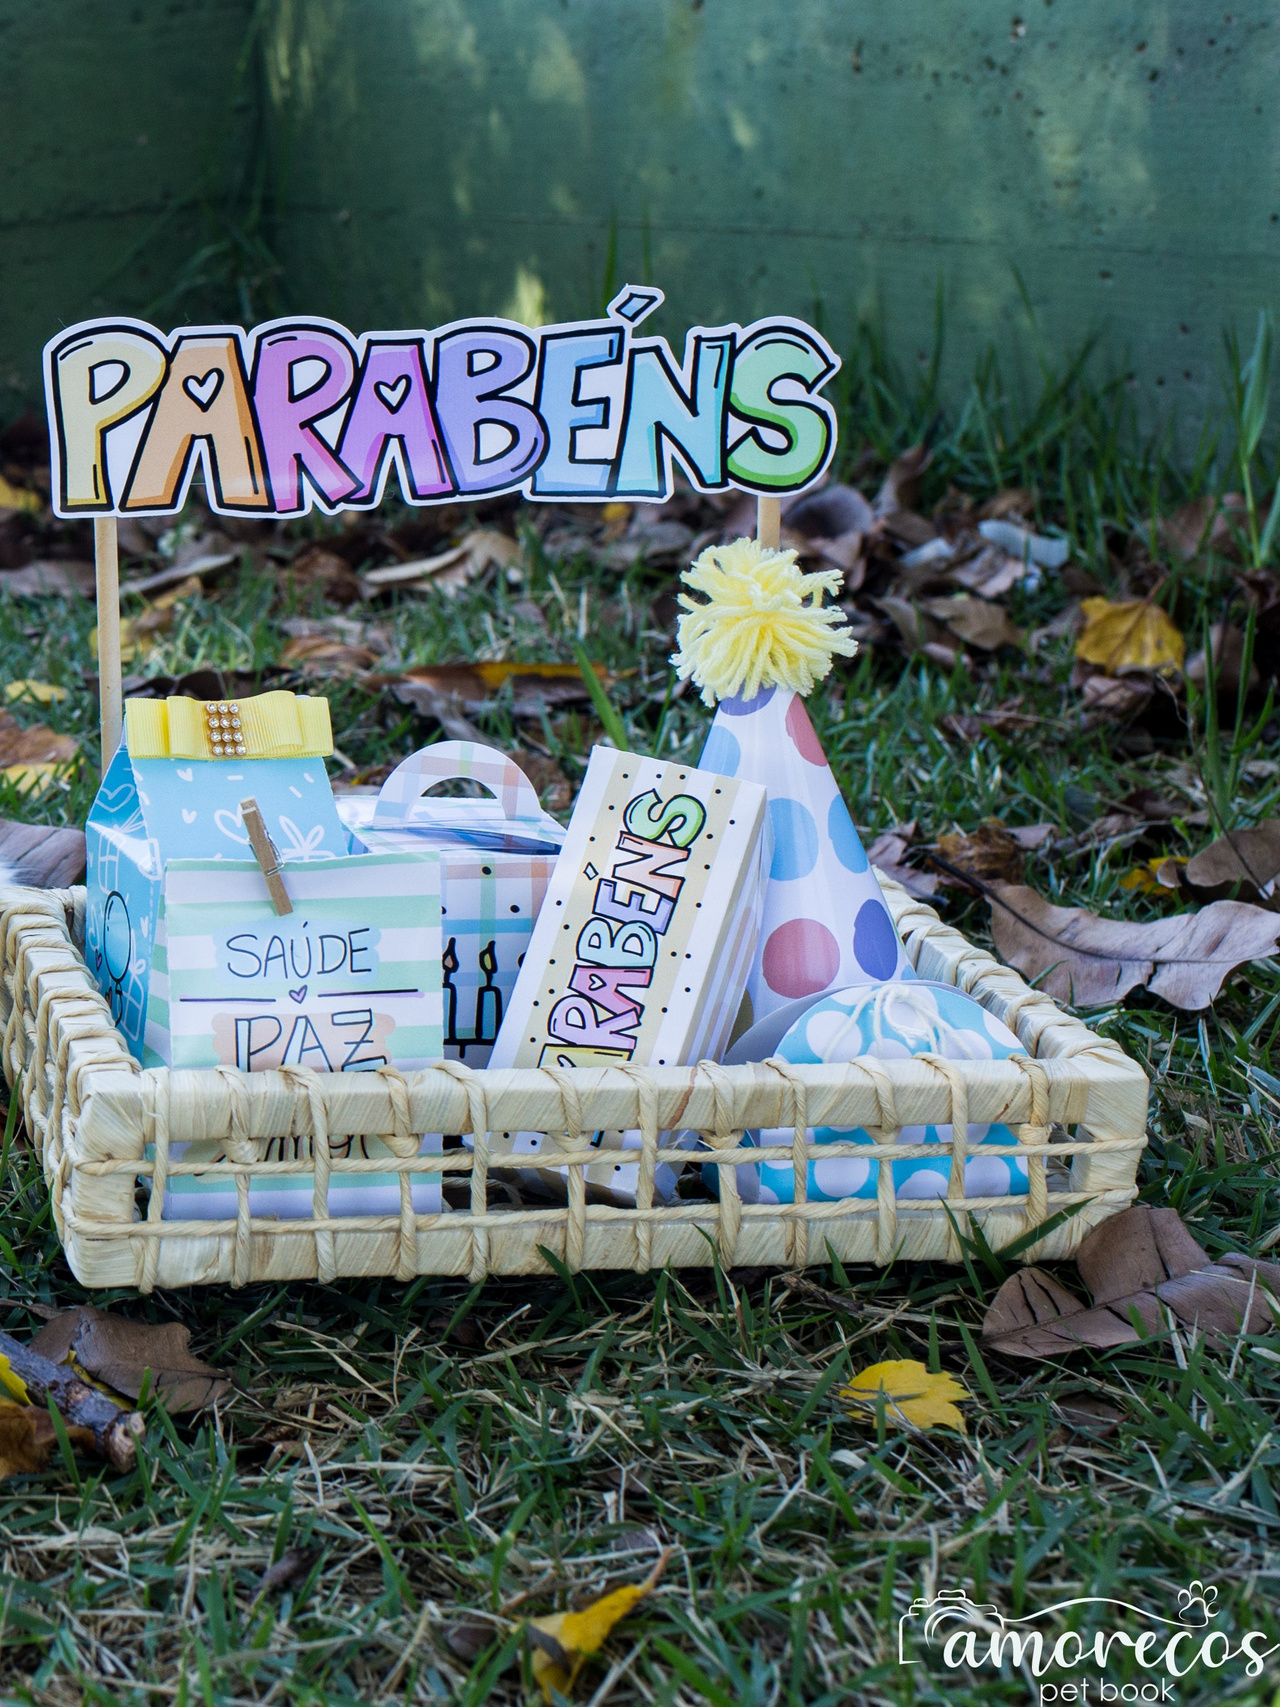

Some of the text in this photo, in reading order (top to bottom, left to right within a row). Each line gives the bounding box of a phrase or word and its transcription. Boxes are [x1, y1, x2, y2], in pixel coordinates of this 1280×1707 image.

[51, 291, 837, 514] PARABÉNS
[226, 921, 372, 979] SAÚDE
[535, 788, 708, 1148] RABÉNS
[234, 1008, 388, 1073] PAZ
